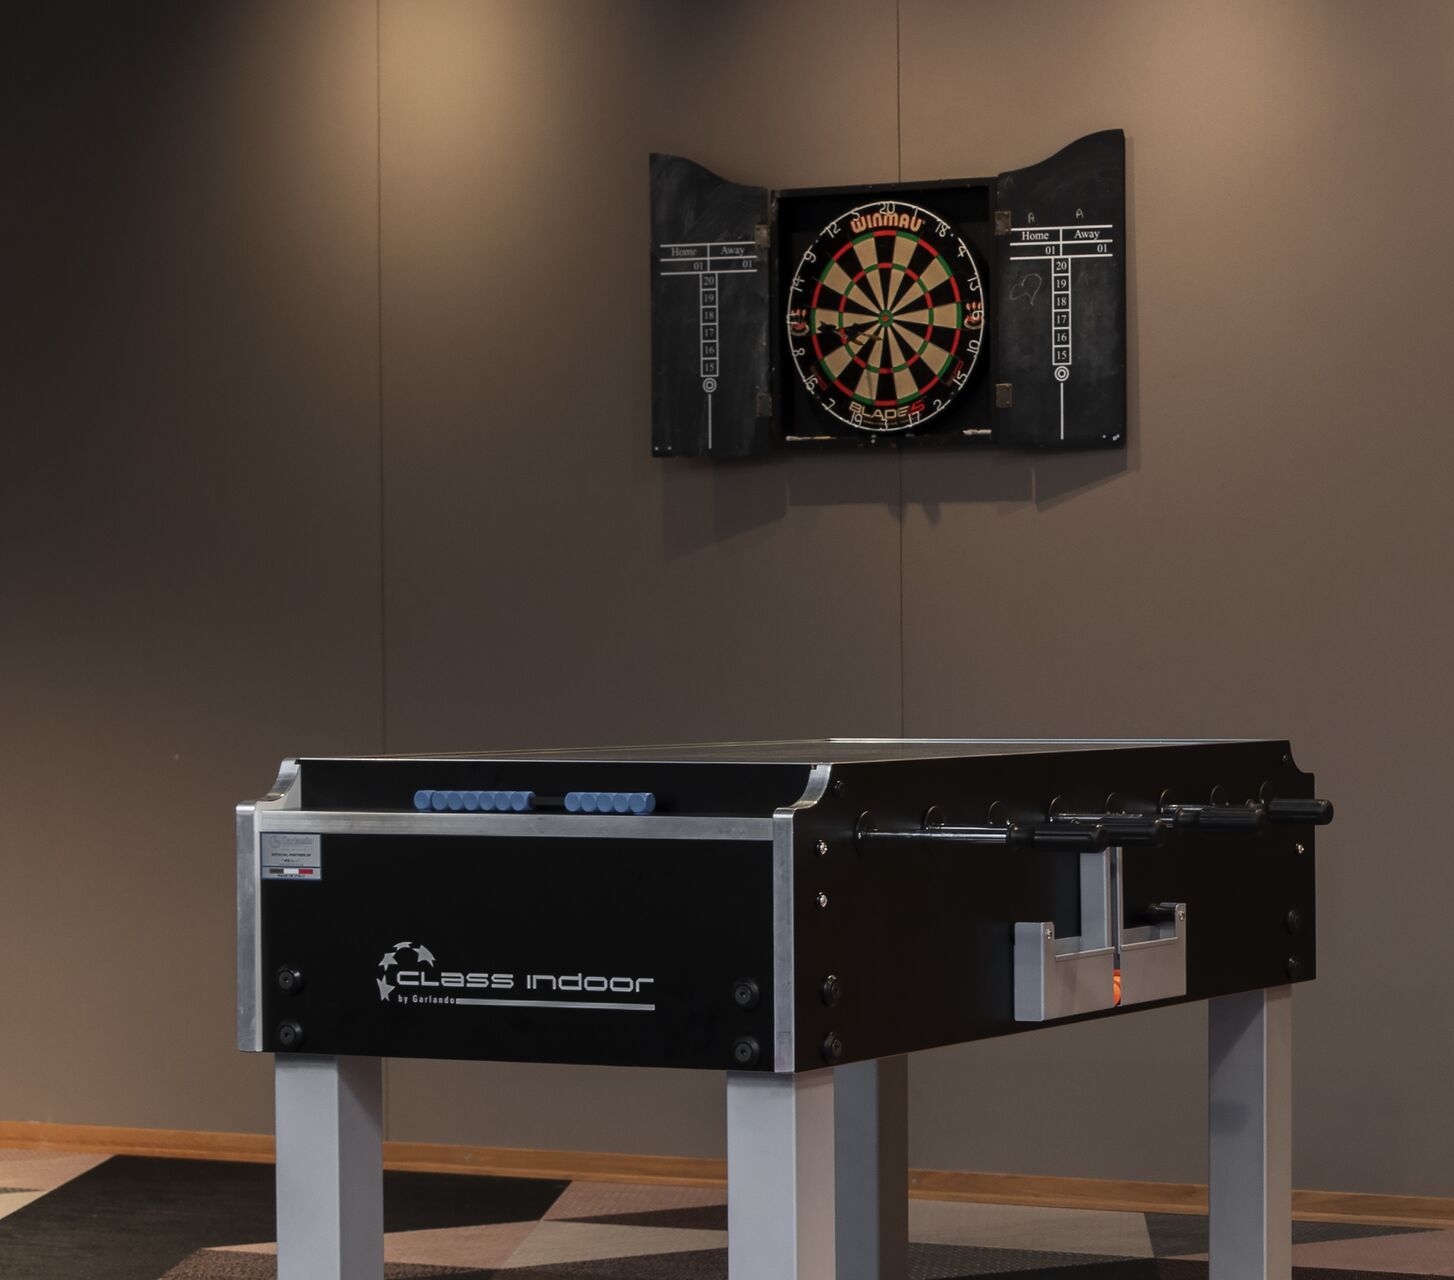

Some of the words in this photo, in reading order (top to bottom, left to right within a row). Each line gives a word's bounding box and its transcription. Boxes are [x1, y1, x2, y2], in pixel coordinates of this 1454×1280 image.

[879, 202, 895, 215] 20
[823, 222, 842, 238] 12
[935, 219, 950, 238] 18
[1021, 231, 1050, 241] Home
[1074, 229, 1100, 241] Away
[671, 247, 698, 258] Home
[720, 245, 746, 258] Away
[1045, 247, 1056, 256] 01
[1097, 244, 1108, 253] 01
[693, 261, 704, 270] 01
[742, 260, 753, 269] 01
[1055, 261, 1067, 270] 20
[703, 276, 715, 286] 20
[1055, 279, 1067, 288] 19
[703, 293, 715, 303] 19
[1055, 297, 1067, 306] 18
[703, 311, 715, 321] 18
[1055, 315, 1067, 324] 17
[703, 328, 715, 338] 17
[1055, 333, 1067, 342] 16
[703, 345, 715, 355] 16
[1055, 351, 1067, 360] 15
[703, 362, 715, 372] 15
[398, 994, 409, 1005] by
[412, 994, 455, 1004] Garlando
